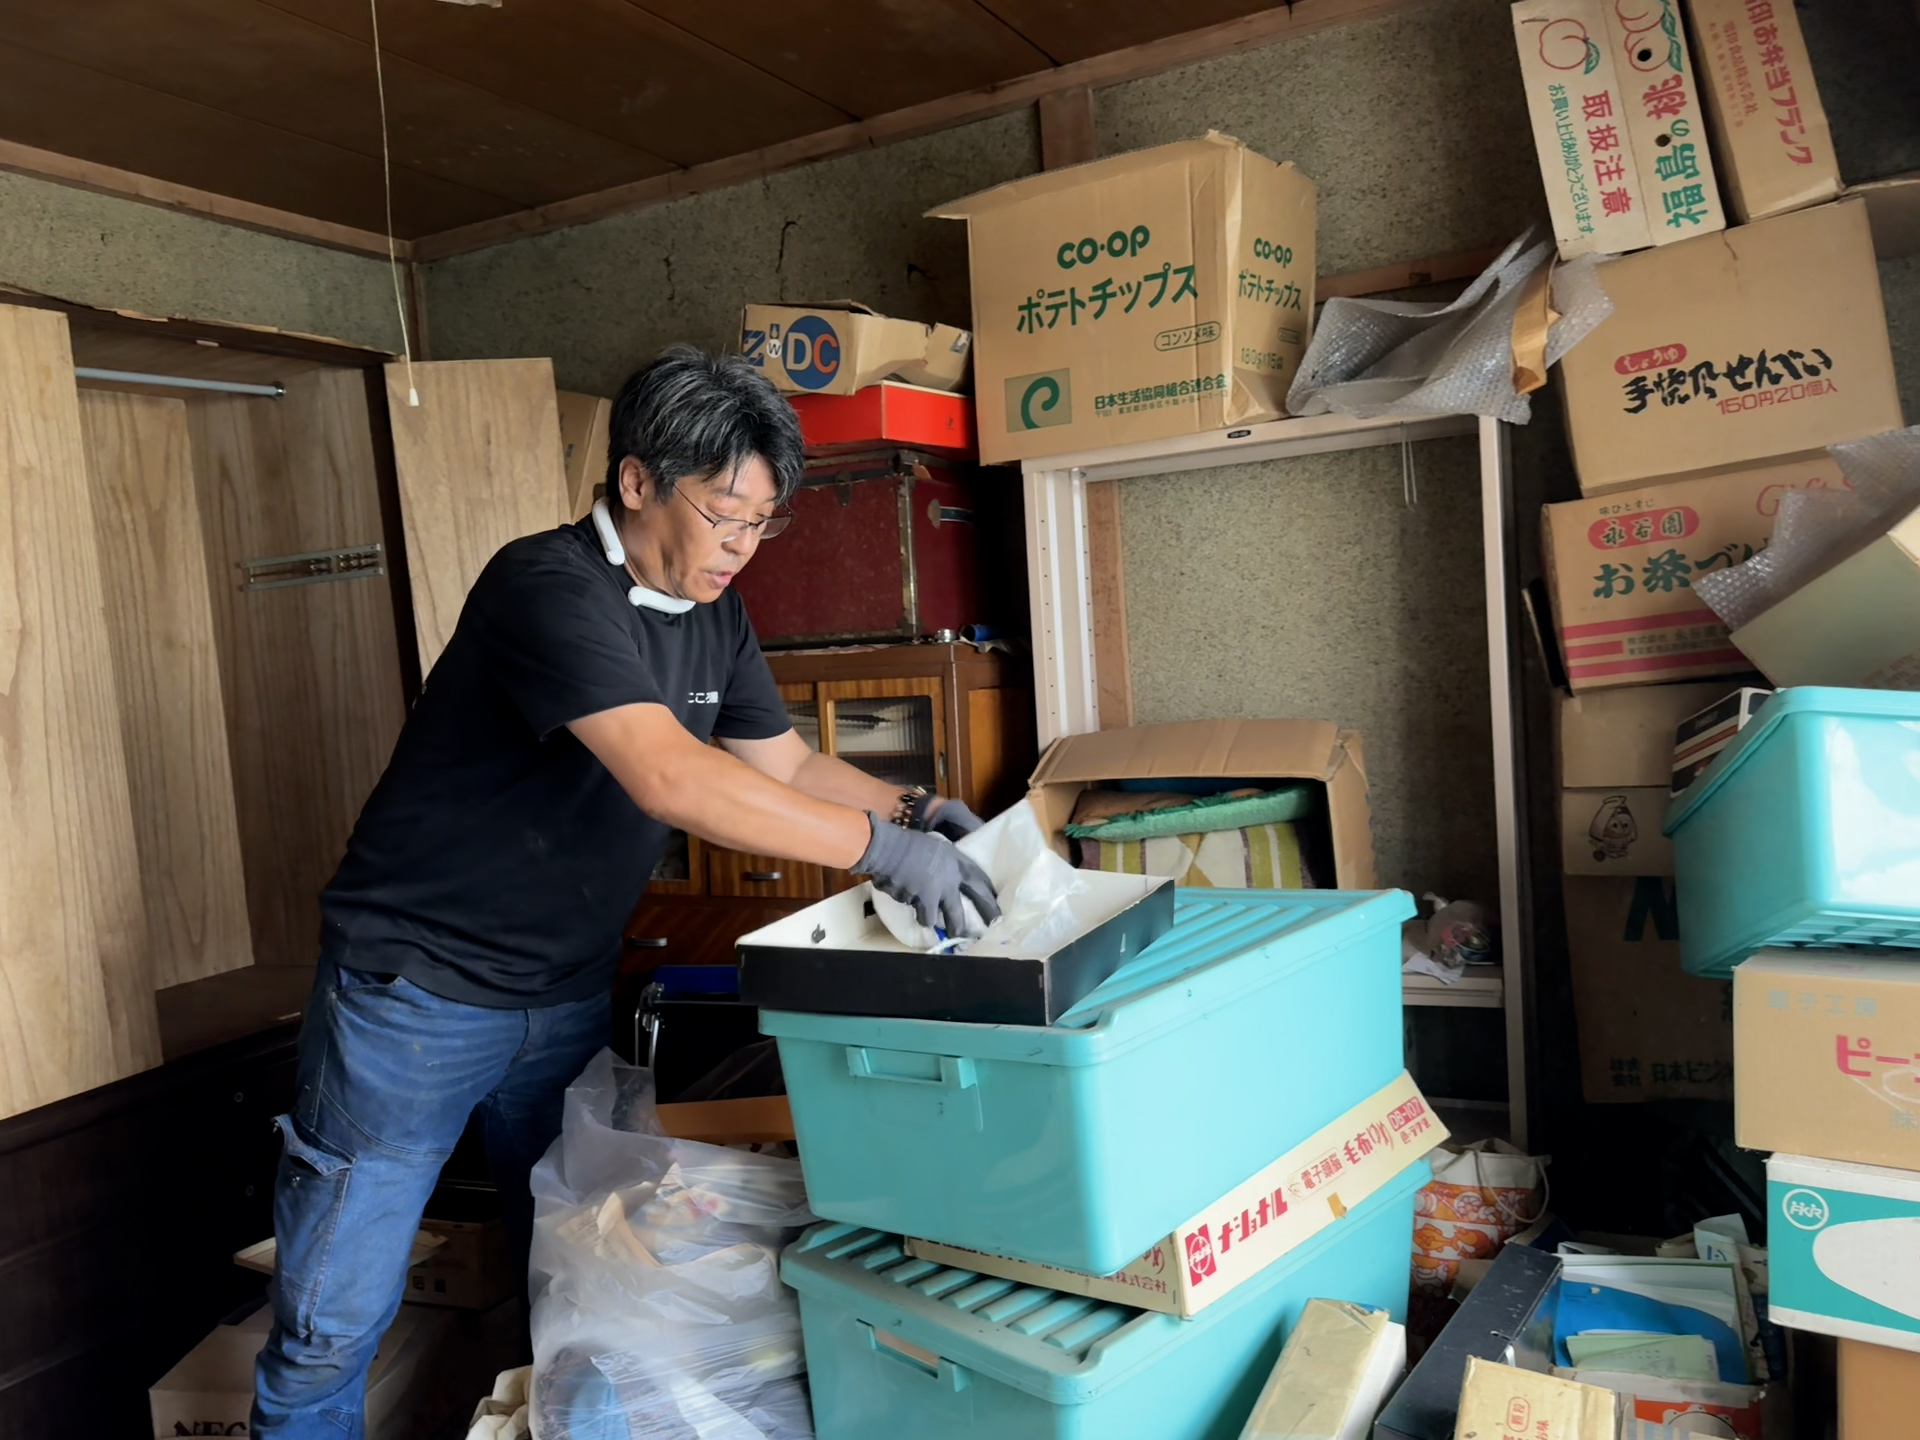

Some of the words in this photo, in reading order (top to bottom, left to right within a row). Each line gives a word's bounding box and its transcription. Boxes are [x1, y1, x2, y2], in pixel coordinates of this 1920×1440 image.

[1744, 0, 1813, 165] 印お弁当フランク
[1581, 90, 1632, 217] 取扱注意
[1642, 74, 1709, 228] 福島の桃
[1016, 263, 1199, 334] ポテトチップス
[1238, 268, 1302, 311] ポテトチップス
[1160, 325, 1217, 347] コンソメ味
[1623, 346, 1680, 372] しょうゆ
[1094, 373, 1228, 410] 日本生活協同組合連合会
[1715, 378, 1839, 416] 150円20個入
[1599, 499, 1655, 515] 味ひとすじ
[1592, 537, 1768, 599] お茶づ
[1836, 1034, 1920, 1084] ピー
[1217, 1187, 1288, 1254] ナショナル
[1390, 1098, 1422, 1129] DB-107
